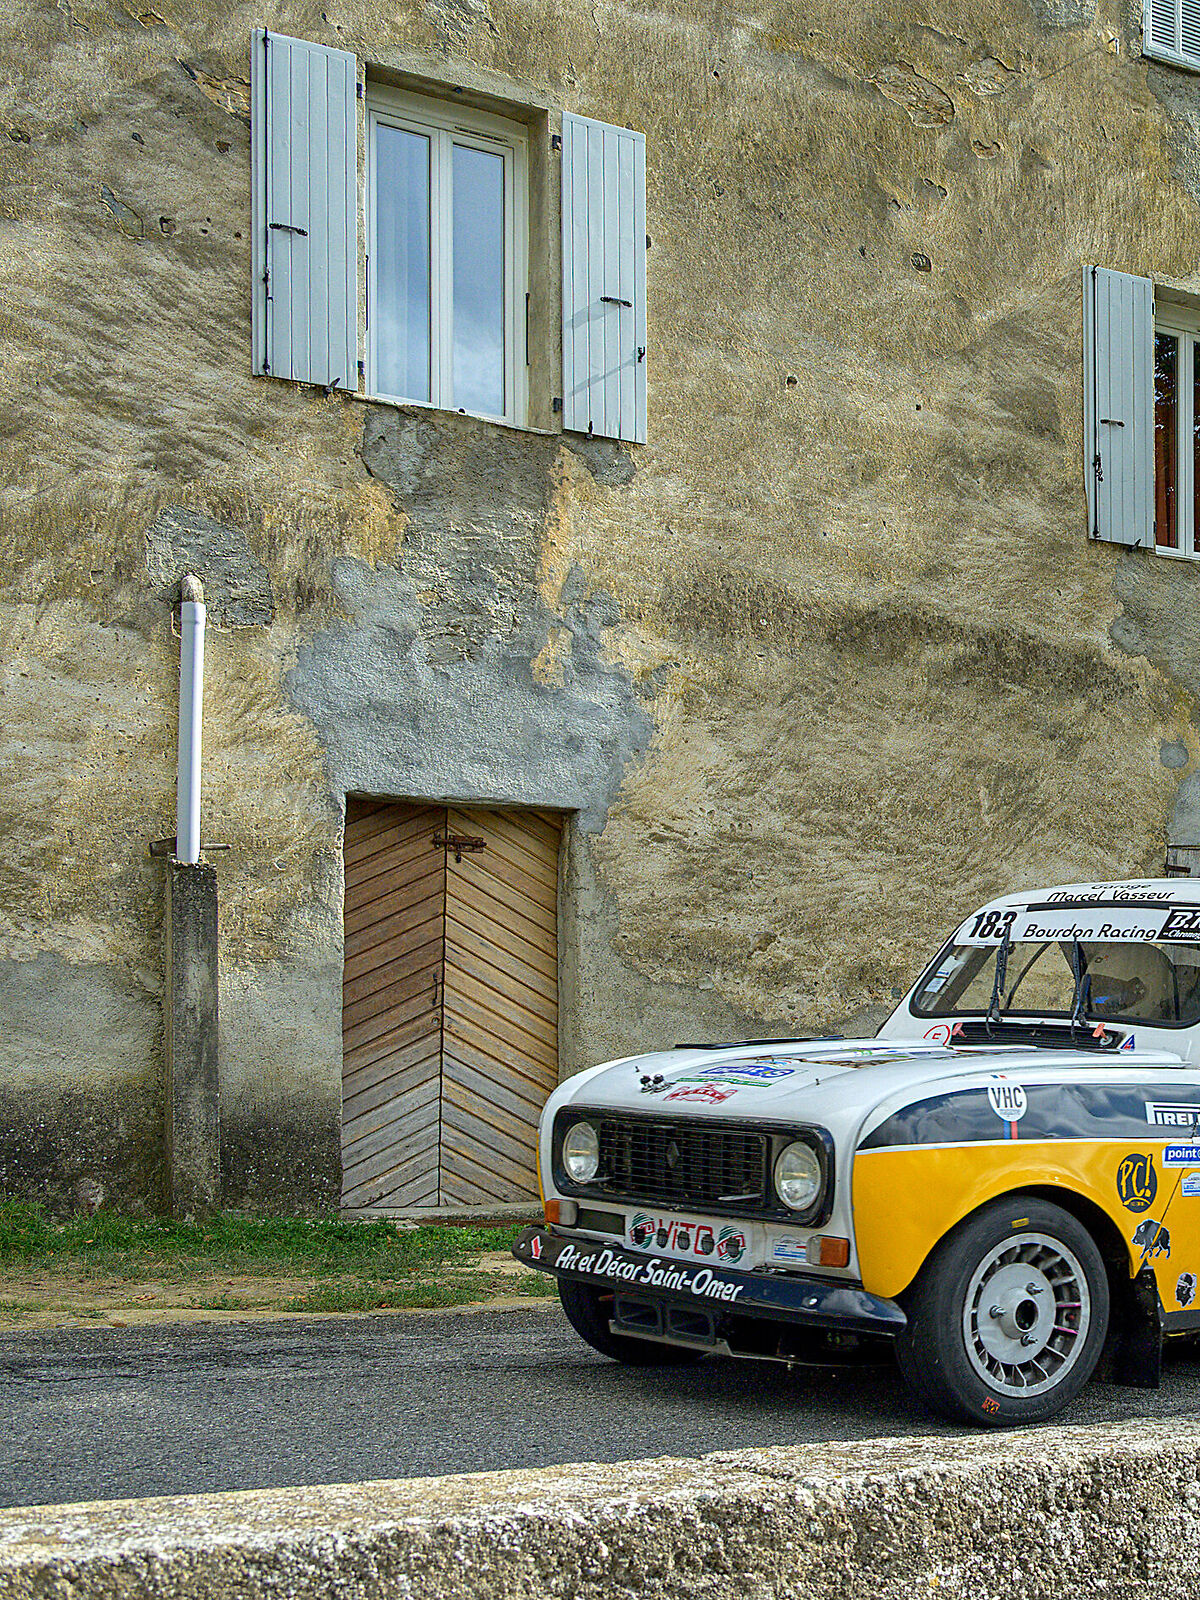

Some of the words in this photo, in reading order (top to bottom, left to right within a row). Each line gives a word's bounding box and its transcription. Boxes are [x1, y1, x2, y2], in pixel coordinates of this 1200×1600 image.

[1047, 890, 1103, 902] Marcel
[1112, 889, 1175, 901] Vasseur
[968, 911, 1017, 940] 183
[1022, 923, 1095, 940] Bourdon
[1099, 922, 1157, 941] Racing
[990, 1086, 1023, 1109] VHC
[1167, 1146, 1198, 1160] point
[1119, 1154, 1152, 1198] PC!
[554, 1244, 577, 1270] Art
[577, 1249, 597, 1273] et
[593, 1248, 644, 1282] Décor
[639, 1258, 745, 1302] Saint-Omer
